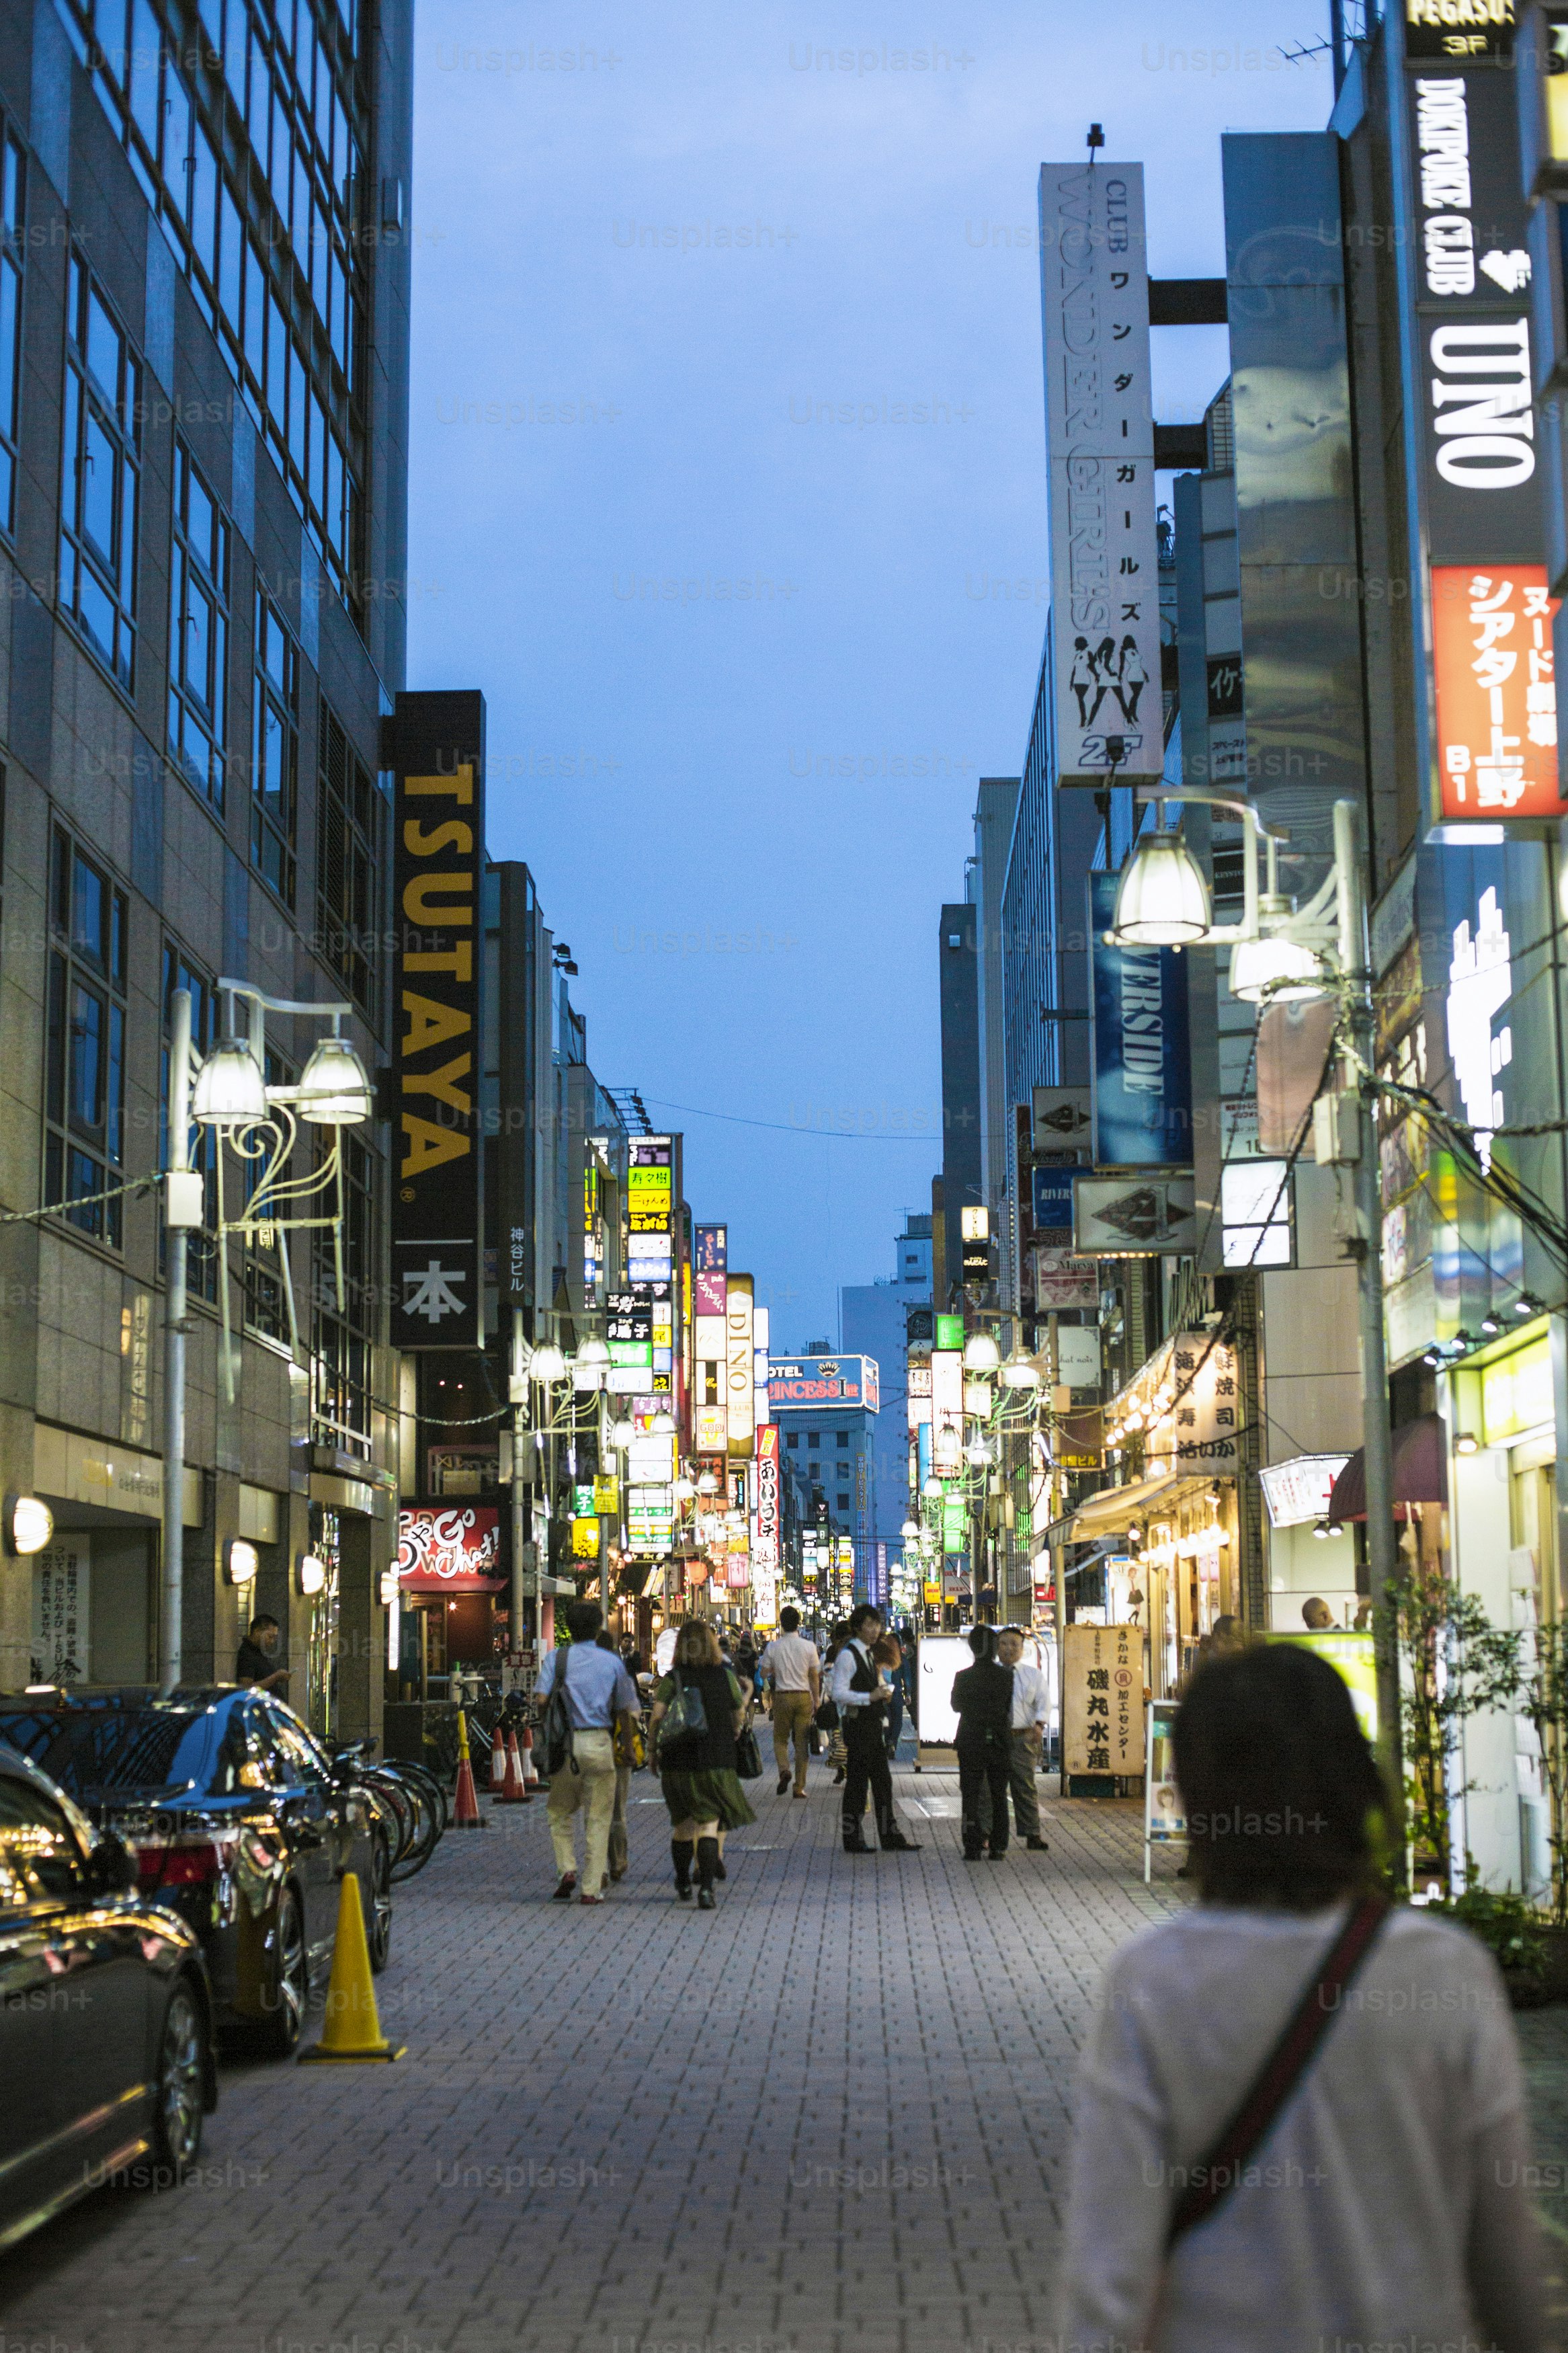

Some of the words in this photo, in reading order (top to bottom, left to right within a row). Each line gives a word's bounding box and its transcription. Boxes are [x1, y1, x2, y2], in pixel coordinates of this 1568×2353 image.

[1106, 180, 1128, 254] CLUB
[1424, 215, 1475, 296] CLUB
[1058, 170, 1103, 438] WONDER
[1430, 318, 1535, 489] UNO
[1110, 271, 1141, 623] ワンダーガールズ
[1067, 443, 1111, 633] GIRLS
[1469, 575, 1524, 809] シアター上野
[401, 764, 474, 1179] TSUTAYA
[632, 1172, 667, 1185] 寿々樹
[632, 1194, 668, 1207] 二けんめ
[509, 1226, 525, 1292] 神谷ビル
[629, 1218, 668, 1231] ながい
[401, 1260, 467, 1324] 本
[711, 1275, 724, 1283] pub
[729, 1312, 751, 1392] DINO
[1086, 1668, 1110, 1770] 磯丸水産
